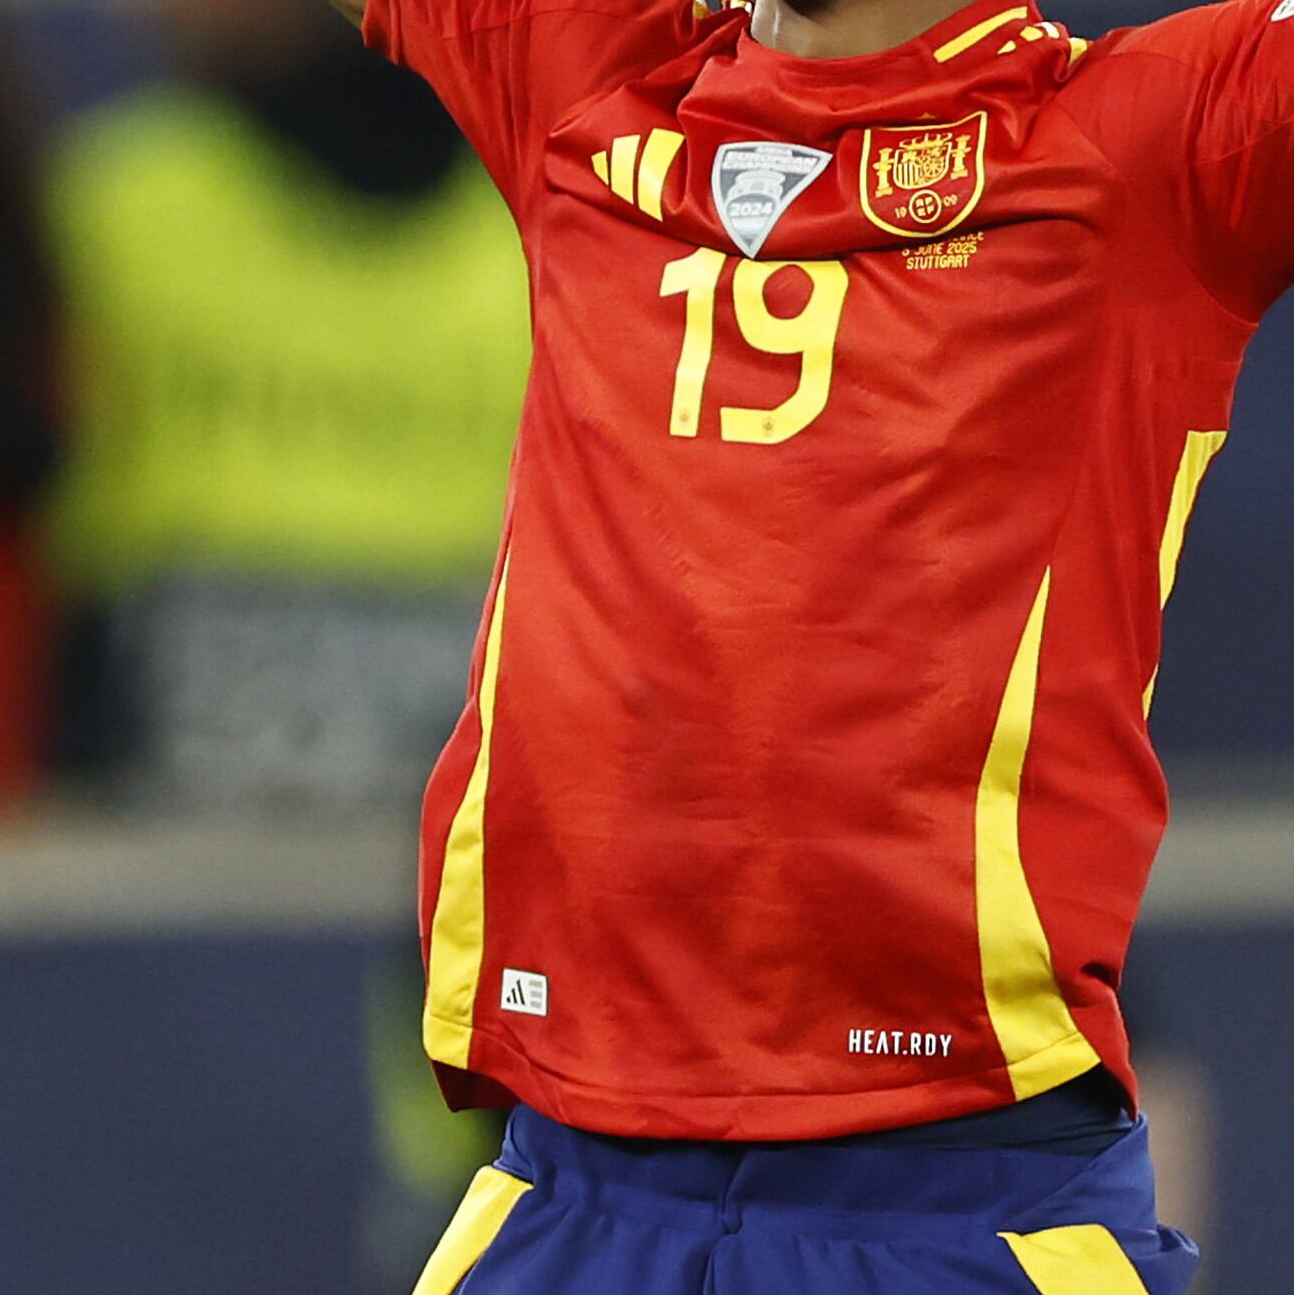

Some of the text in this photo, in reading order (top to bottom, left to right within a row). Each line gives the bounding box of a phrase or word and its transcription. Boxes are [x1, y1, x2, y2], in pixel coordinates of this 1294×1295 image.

[729, 201, 774, 217] 2024
[914, 243, 945, 256] JUNE
[947, 240, 978, 255] 2025
[906, 253, 970, 270] STUTTGART
[659, 247, 850, 444] 19
[848, 1028, 953, 1058] HEAT.RDY
